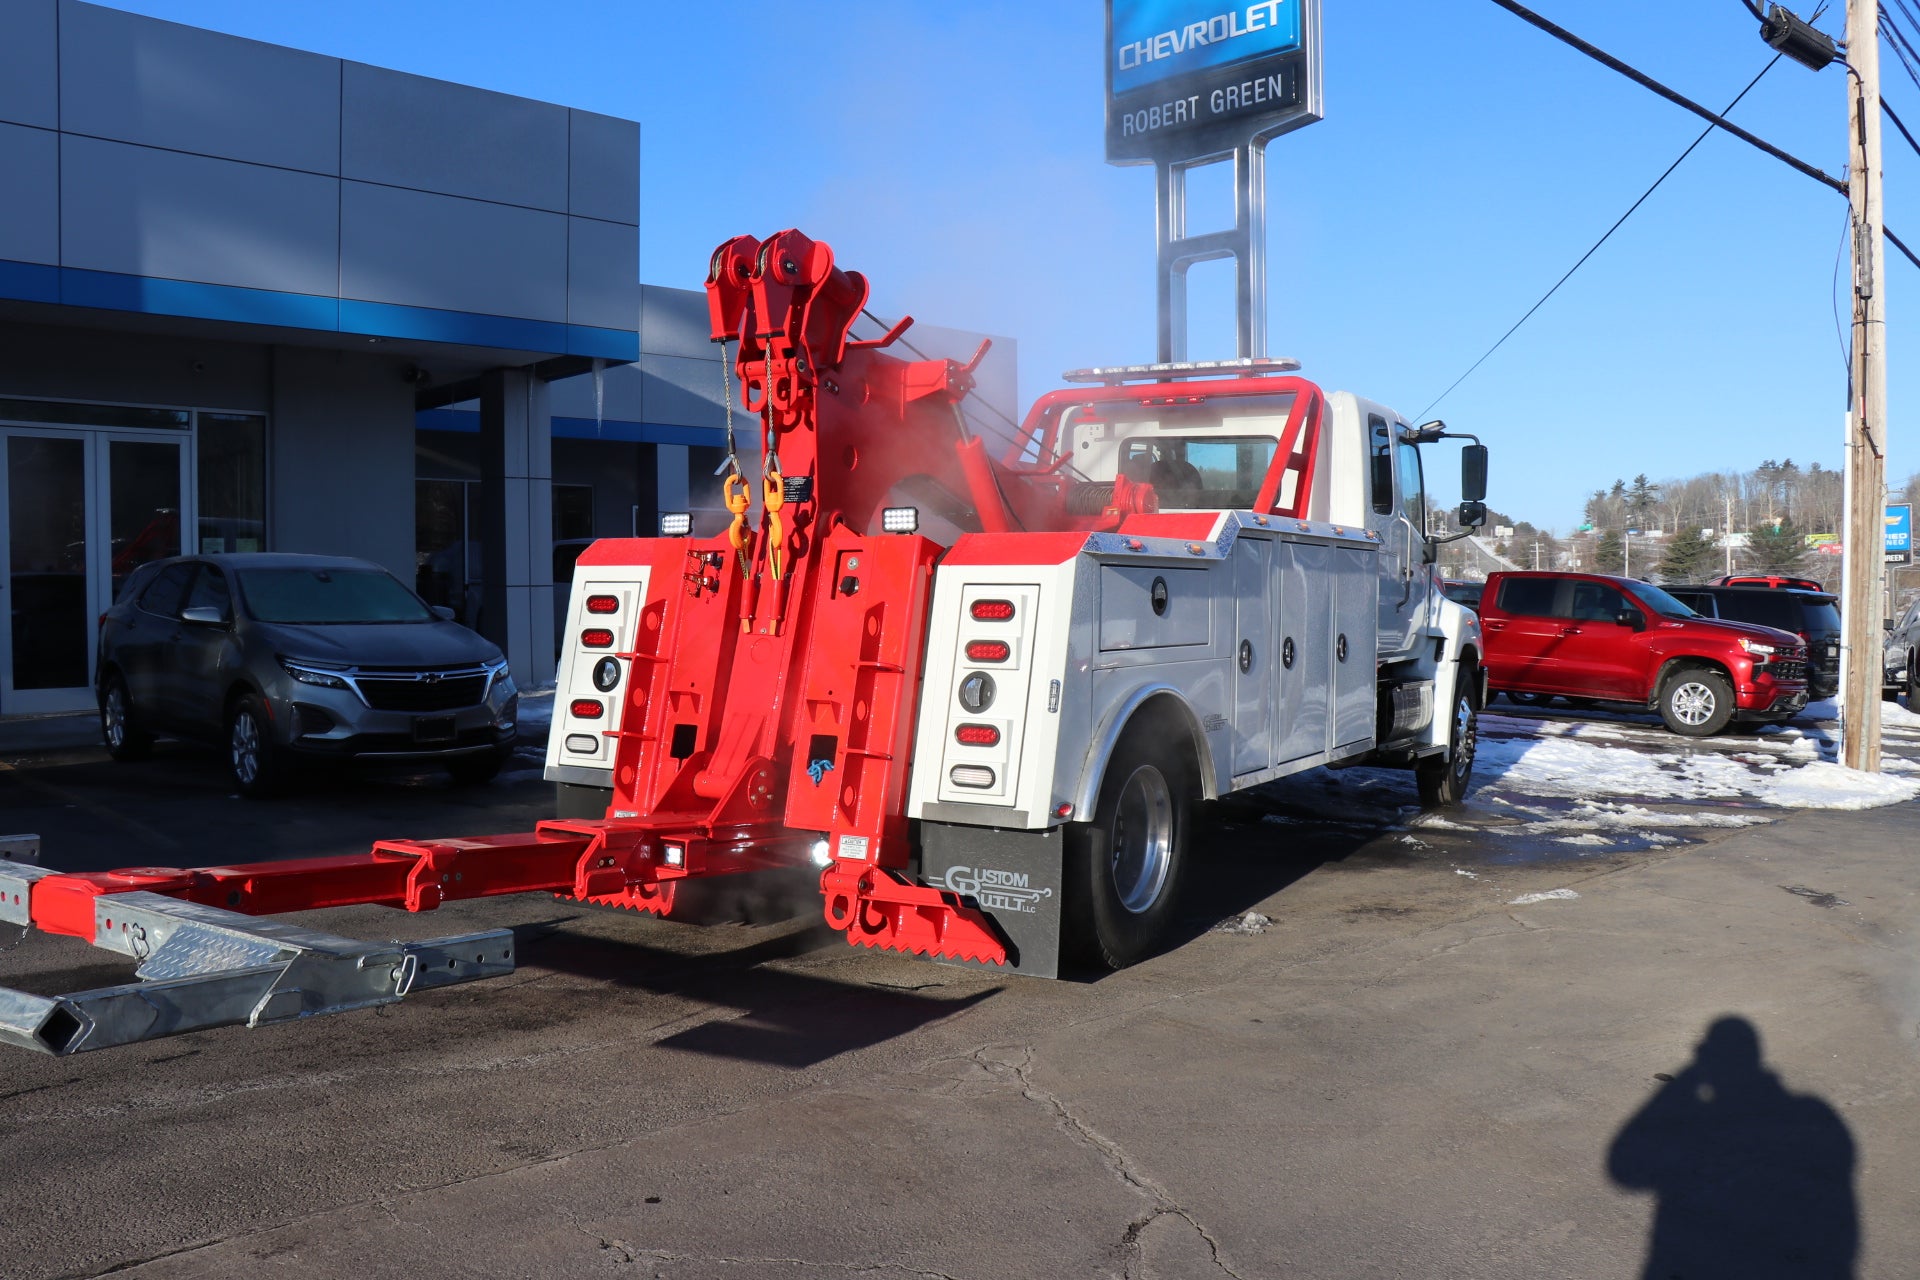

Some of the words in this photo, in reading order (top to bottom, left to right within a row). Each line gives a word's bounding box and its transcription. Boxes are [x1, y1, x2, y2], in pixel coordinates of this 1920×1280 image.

[1119, 0, 1283, 71] CHEVROLET
[1123, 95, 1199, 137] ROBERT
[1210, 73, 1282, 114] GREEN
[945, 865, 1029, 893] CUSTOM
[1022, 905, 1036, 914] LLC
